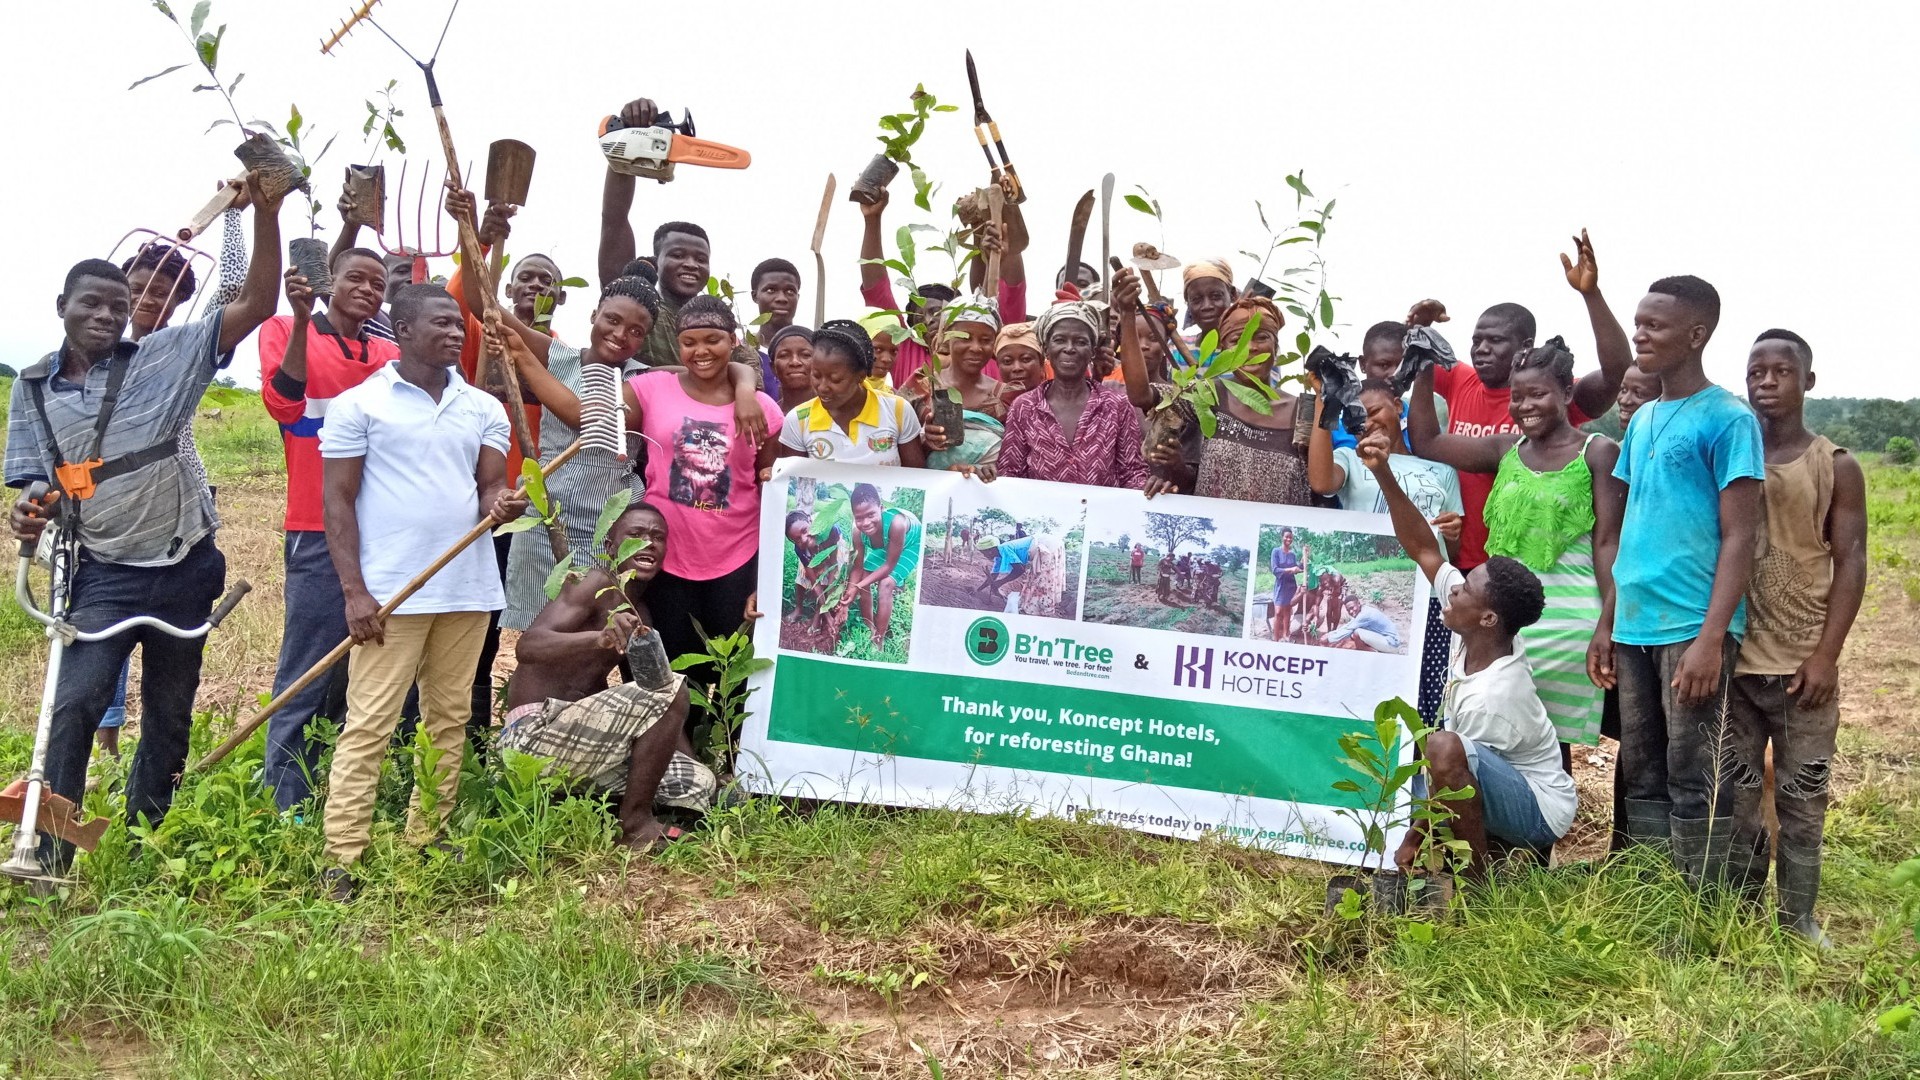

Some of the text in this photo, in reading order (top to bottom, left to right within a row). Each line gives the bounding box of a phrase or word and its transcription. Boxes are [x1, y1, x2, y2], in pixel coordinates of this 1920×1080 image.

[1014, 633, 1114, 664] B'n'Tree
[1134, 653, 1149, 670] &
[1014, 654, 1028, 663] You
[1065, 661, 1081, 669] tree.
[1084, 662, 1095, 670] For
[1096, 664, 1112, 672] free!
[1066, 669, 1110, 679] Bedandtree.com
[1223, 650, 1328, 677] KONCEPT
[1221, 673, 1303, 699] HOTELS
[941, 695, 1221, 746] Thank you, Koncept Hotels,
[964, 726, 1193, 769] for reforesting Ghana!
[1107, 810, 1145, 824] trees
[1149, 814, 1191, 832] today
[1194, 821, 1212, 832] on
